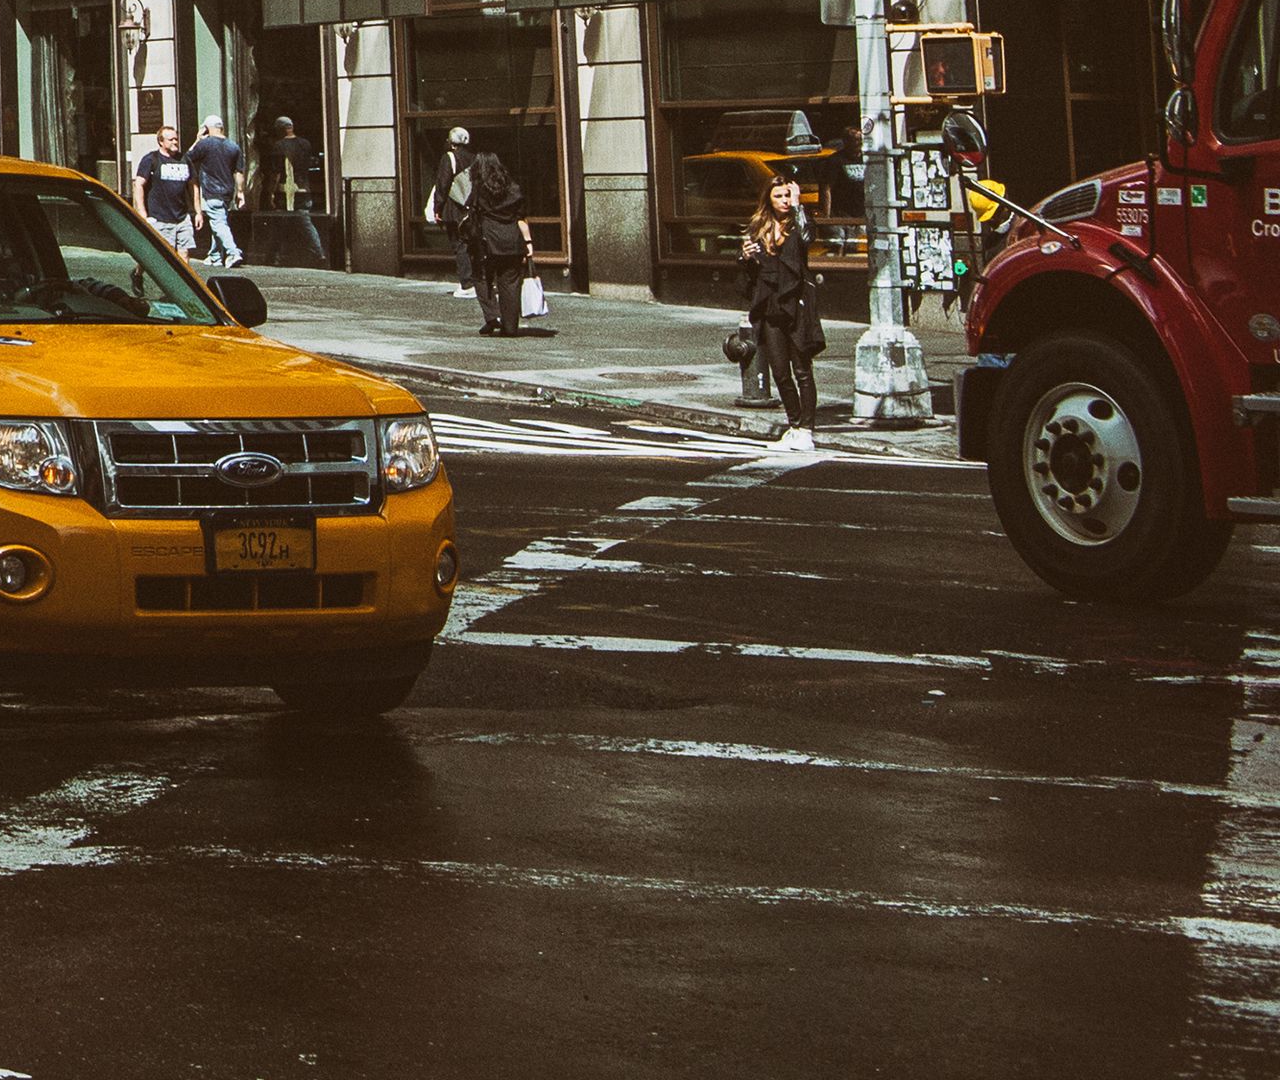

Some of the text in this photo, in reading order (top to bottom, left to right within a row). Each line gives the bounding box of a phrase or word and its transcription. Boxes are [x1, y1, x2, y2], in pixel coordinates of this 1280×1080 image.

[1116, 208, 1149, 223] 553075
[239, 461, 267, 474] Ford
[132, 546, 203, 556] ESCAPE
